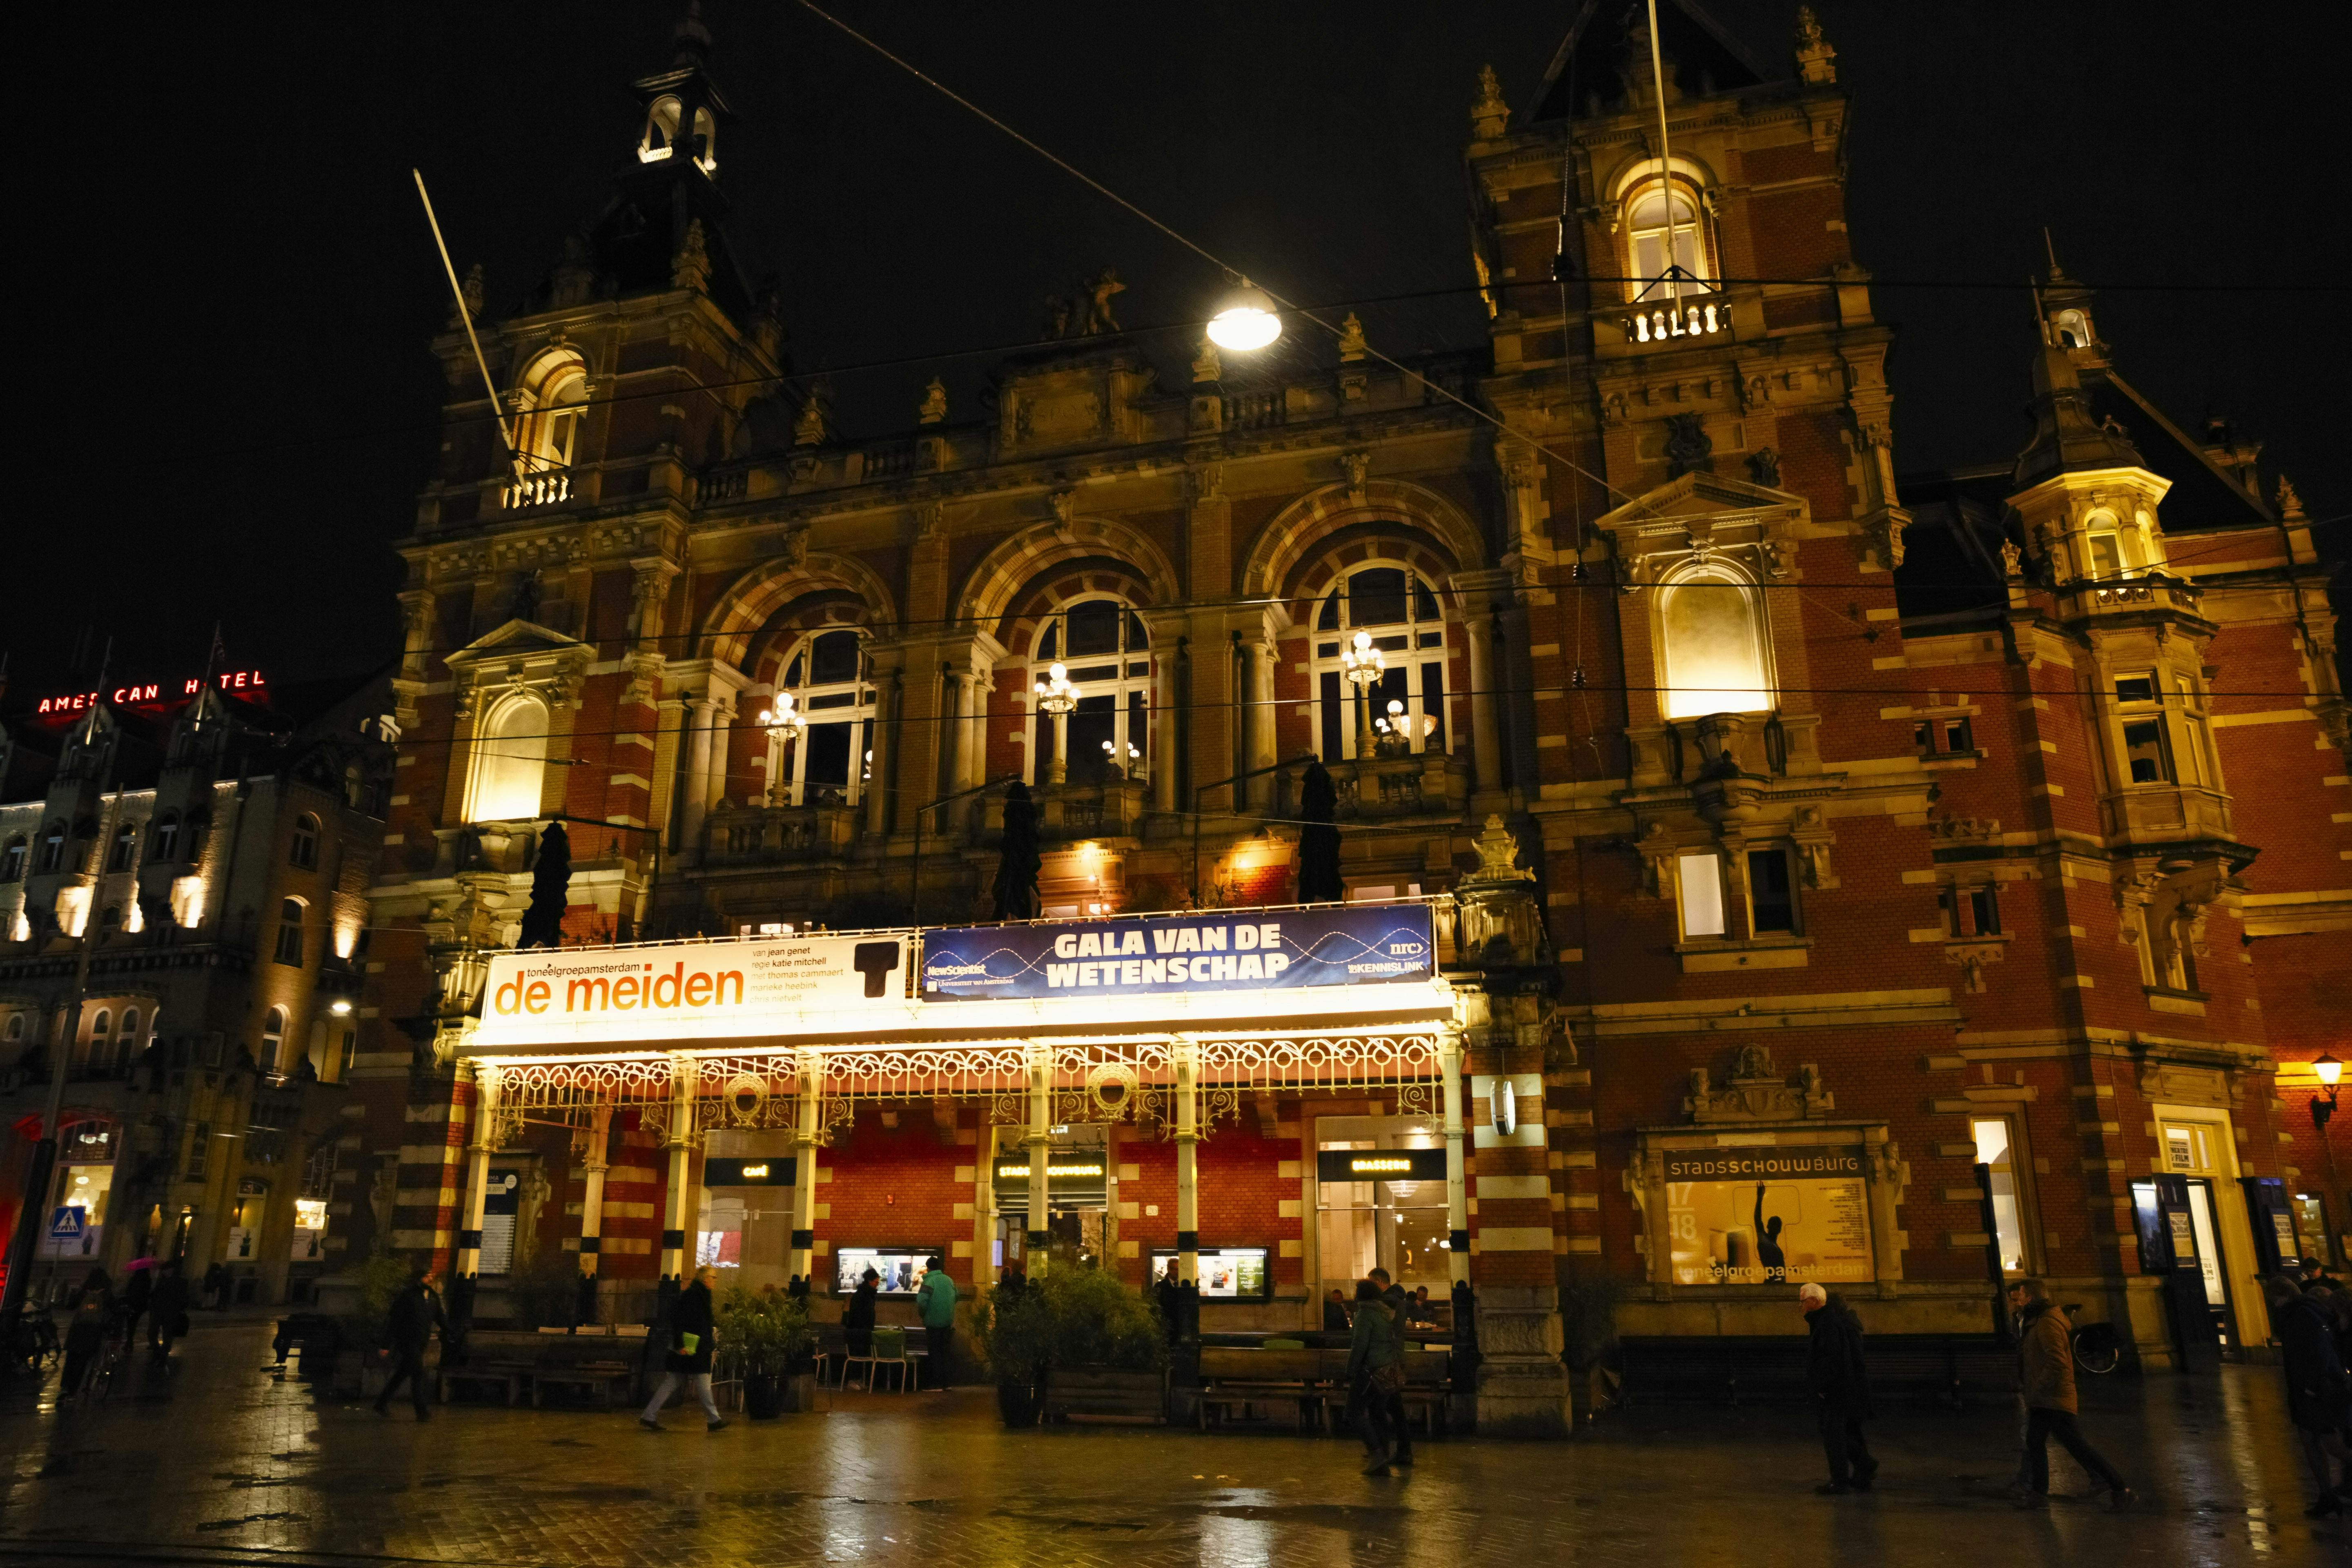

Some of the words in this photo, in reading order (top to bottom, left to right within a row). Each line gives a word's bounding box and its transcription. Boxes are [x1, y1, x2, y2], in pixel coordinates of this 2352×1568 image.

[39, 685, 158, 713] AMECAN
[186, 672, 264, 693] HTEL
[1054, 931, 1146, 958] GALA
[1153, 926, 1227, 953] VAN
[1235, 924, 1280, 950] DE
[768, 949, 785, 957] jean
[787, 947, 811, 956] genet
[752, 960, 770, 970] regie
[794, 957, 826, 966] mitchell
[927, 964, 986, 976] NewScientist
[1046, 953, 1290, 987] WETENSCHAP
[527, 963, 640, 978] toneelgroepamsterdam
[801, 968, 844, 978] cammaert
[495, 971, 551, 1016] de
[566, 961, 744, 1012] meiden
[750, 983, 783, 991] marieke
[785, 981, 818, 990] heebink
[999, 1165, 1102, 1177] STADSOUWBURG
[1352, 1160, 1411, 1171] BRASSERIE
[1669, 1214, 1697, 1239] 18
